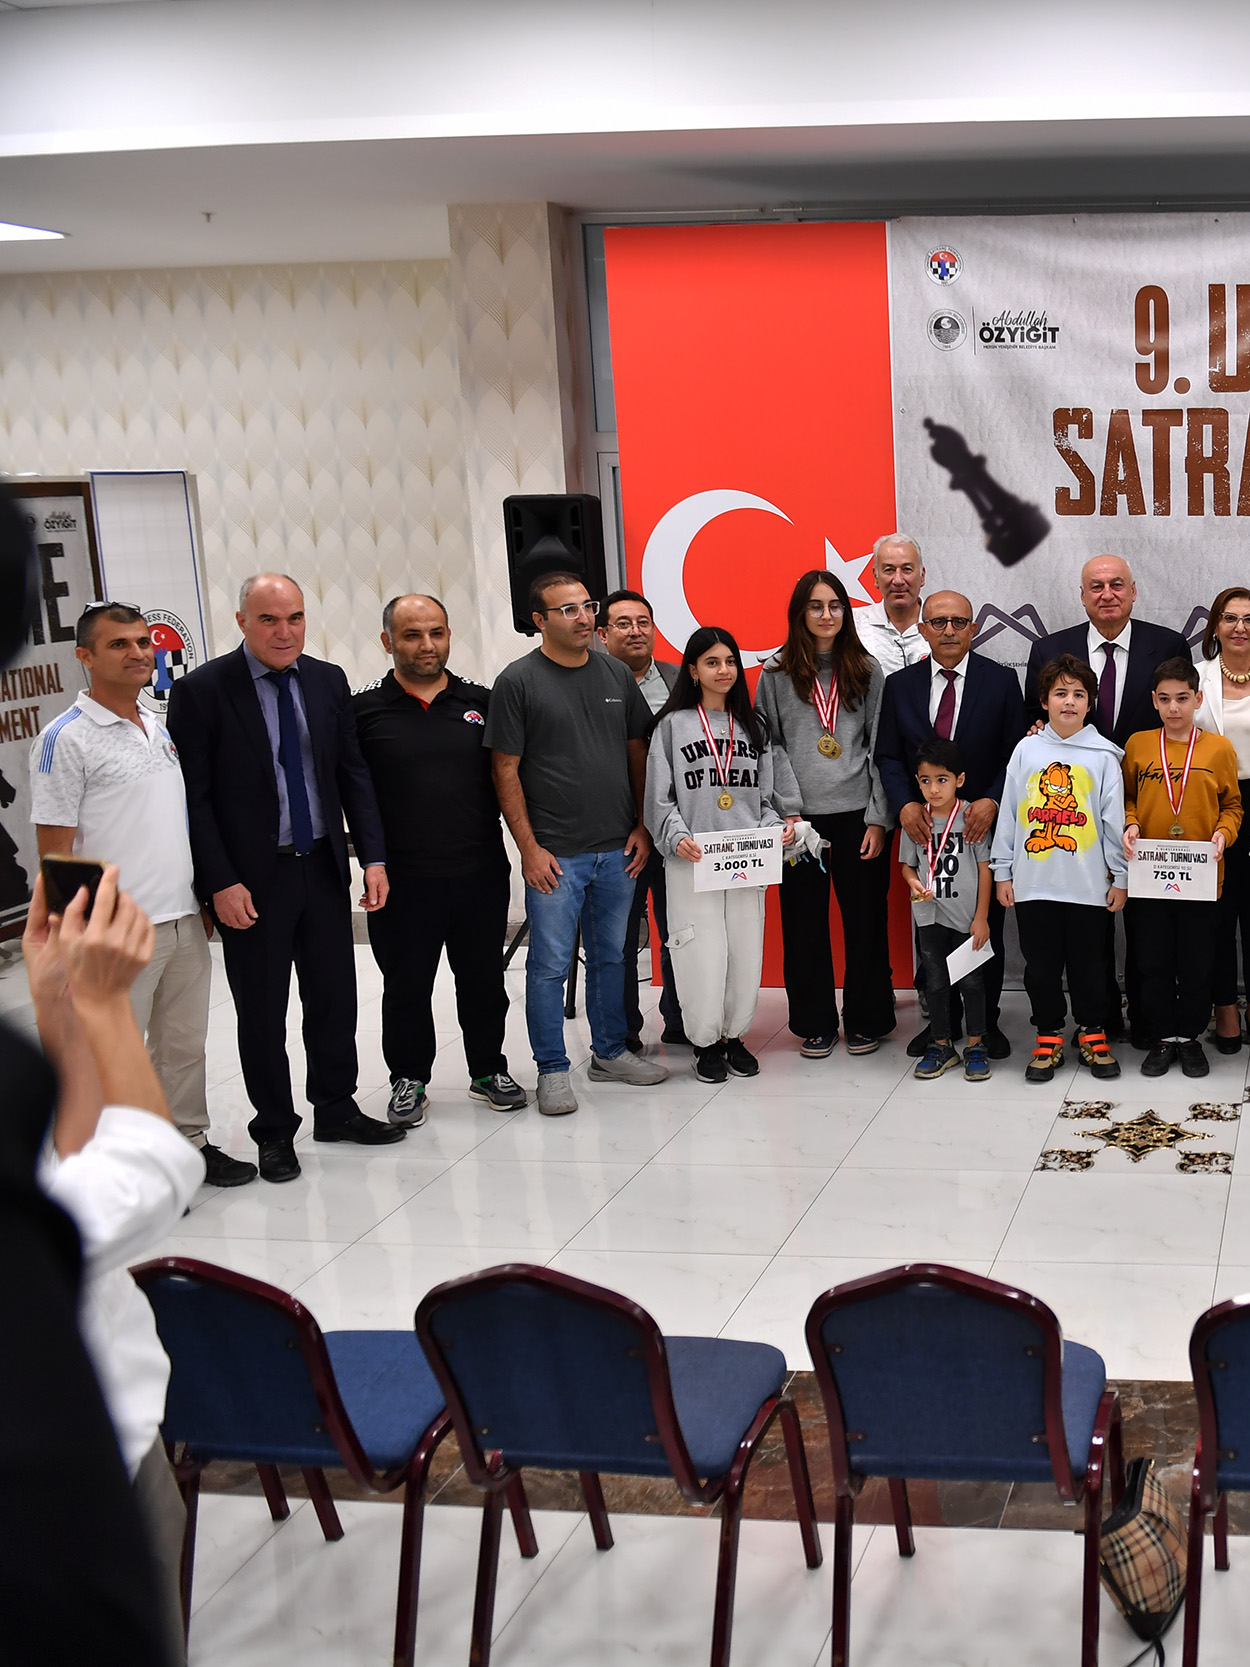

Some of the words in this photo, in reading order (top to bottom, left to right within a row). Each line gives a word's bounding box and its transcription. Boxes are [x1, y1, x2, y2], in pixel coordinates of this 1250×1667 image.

[992, 310, 1047, 327] Abdullah
[1134, 284, 1191, 395] 9.
[163, 614, 194, 660] FEDERATION
[684, 769, 704, 790] OF
[737, 838, 774, 852] TURNUVASI
[714, 860, 748, 872] 3.000
[751, 858, 764, 868] TL
[1138, 851, 1168, 863] SATRANÇ
[1170, 852, 1208, 864] TURNUVASI
[1153, 870, 1175, 880] 750
[1178, 872, 1192, 881] TL
[935, 877, 959, 898] IT.
